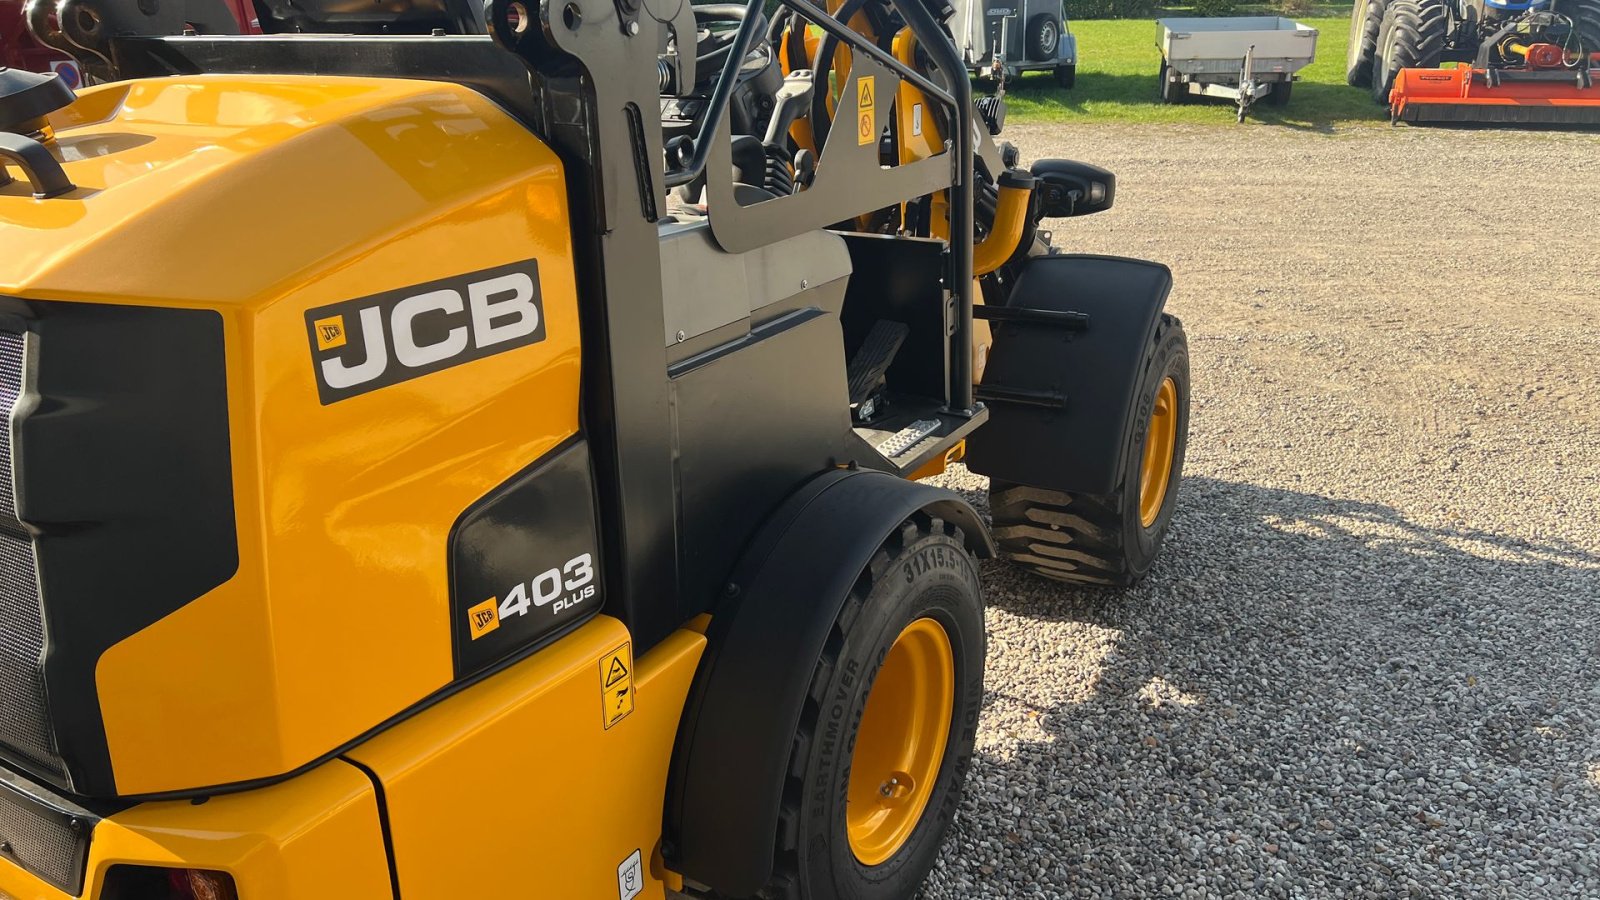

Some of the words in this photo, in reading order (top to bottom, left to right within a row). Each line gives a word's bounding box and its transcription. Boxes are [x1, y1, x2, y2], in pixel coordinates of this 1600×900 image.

[321, 273, 539, 389] JCB
[323, 324, 341, 342] JCB
[498, 552, 594, 621] 403
[553, 584, 596, 615] PLUS
[476, 609, 494, 629] JCB
[812, 658, 860, 818] EARTHMOVER
